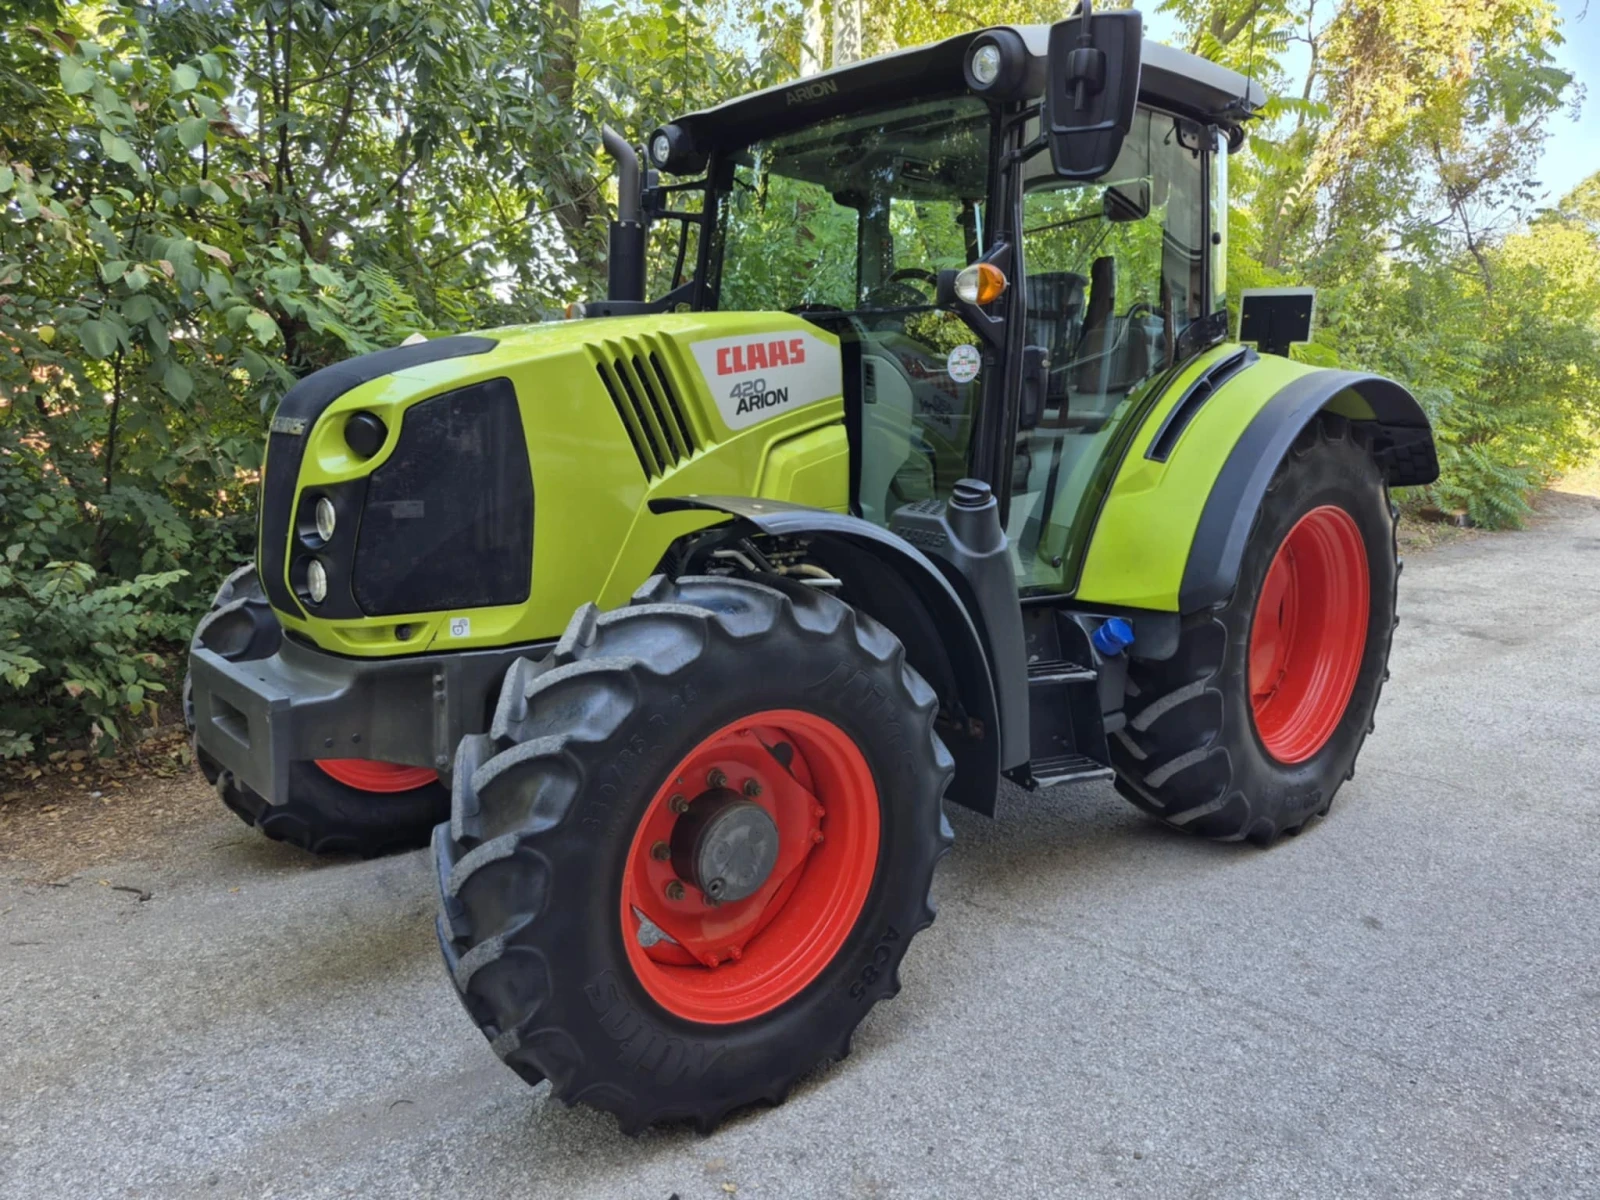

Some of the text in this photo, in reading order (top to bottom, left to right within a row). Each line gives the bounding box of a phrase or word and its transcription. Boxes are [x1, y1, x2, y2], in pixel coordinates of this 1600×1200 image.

[786, 79, 838, 105] ARION
[716, 338, 806, 376] CLAAS
[729, 378, 767, 399] 420
[736, 387, 789, 415] ARION
[849, 924, 901, 1003] AC85
